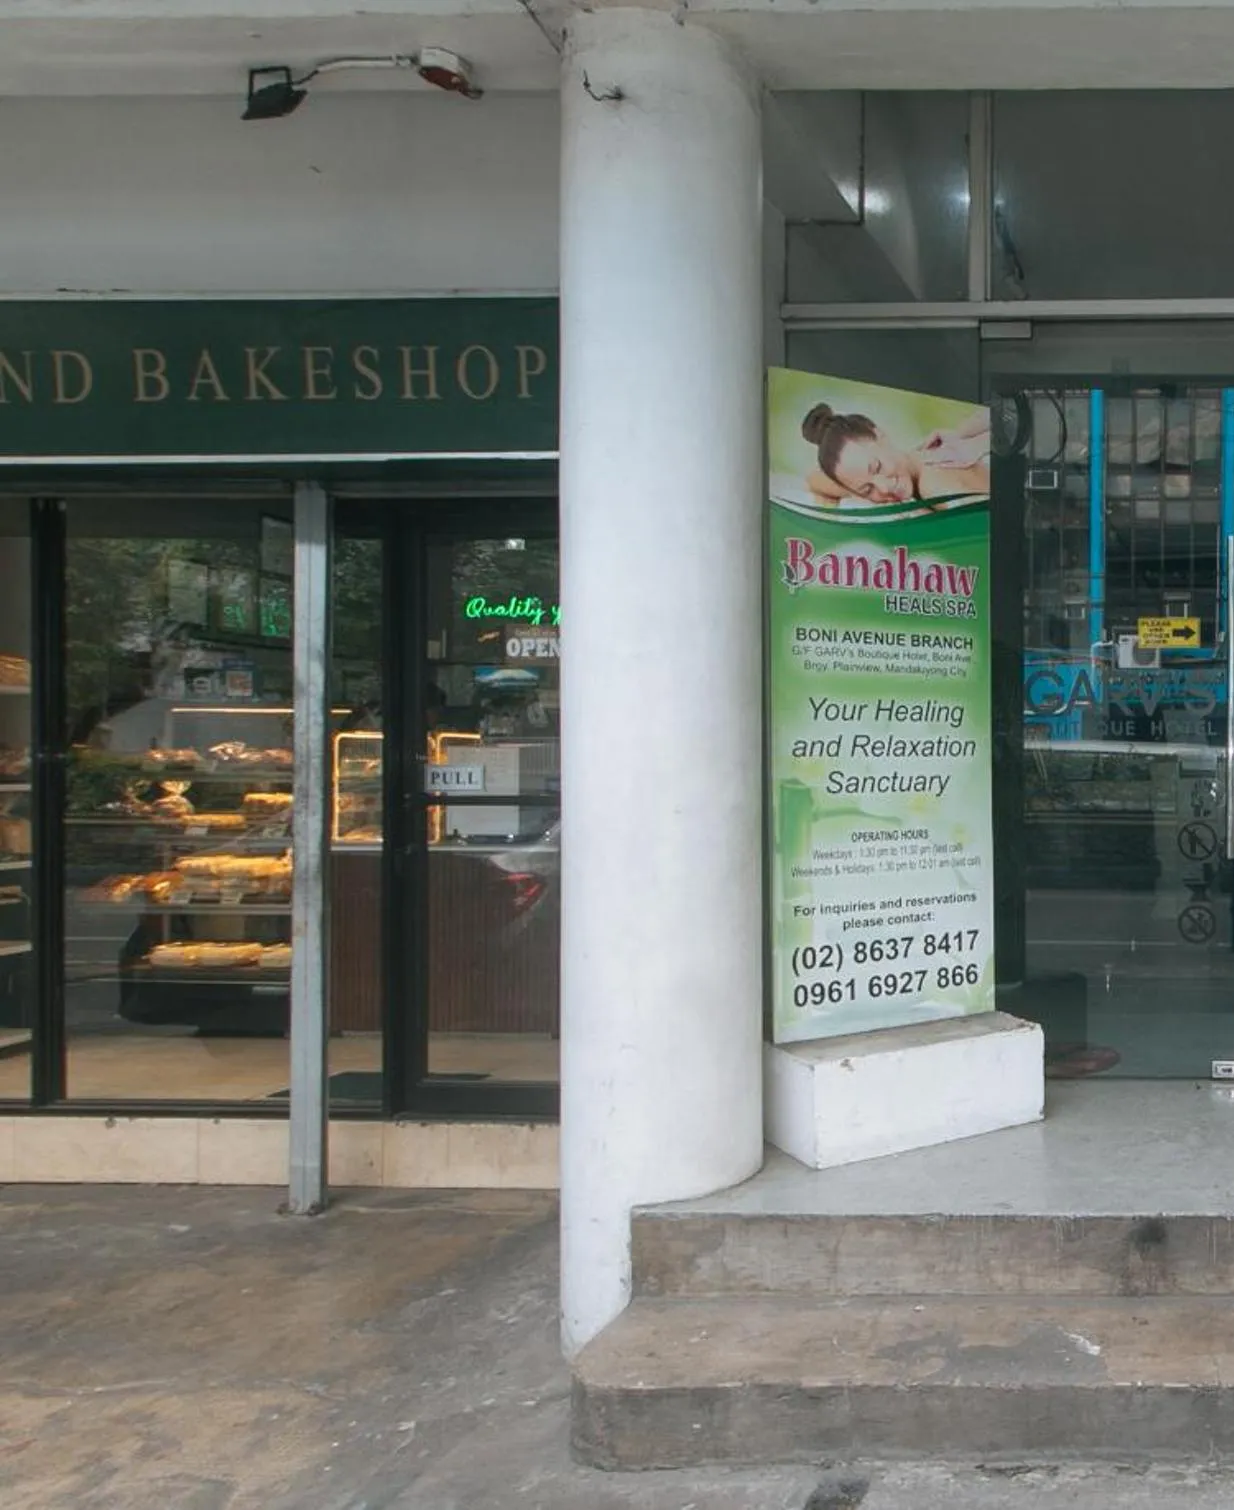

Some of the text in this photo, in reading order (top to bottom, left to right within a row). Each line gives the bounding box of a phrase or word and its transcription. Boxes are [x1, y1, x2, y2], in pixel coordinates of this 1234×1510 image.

[132, 344, 547, 402] BAKESHOP
[785, 537, 978, 598] Banahaw
[466, 597, 546, 625] Quality
[885, 594, 976, 618] HEALS SPA
[796, 627, 973, 650] BONI AVENUE BRANCH
[833, 660, 882, 674] Plainview,
[858, 648, 901, 661] Boutique
[932, 652, 954, 663] Boni
[808, 697, 964, 728] Your Healing
[792, 734, 976, 757] and Relaxation
[430, 771, 479, 785] PULL
[826, 770, 949, 797] Sanctuary
[851, 828, 929, 843] OPERATING HOURS
[793, 892, 977, 917] For inquiries and reservations
[843, 911, 935, 931] please contact:
[792, 929, 979, 976] (02) 8637 8417
[793, 963, 978, 1008] 0961 6927 866
